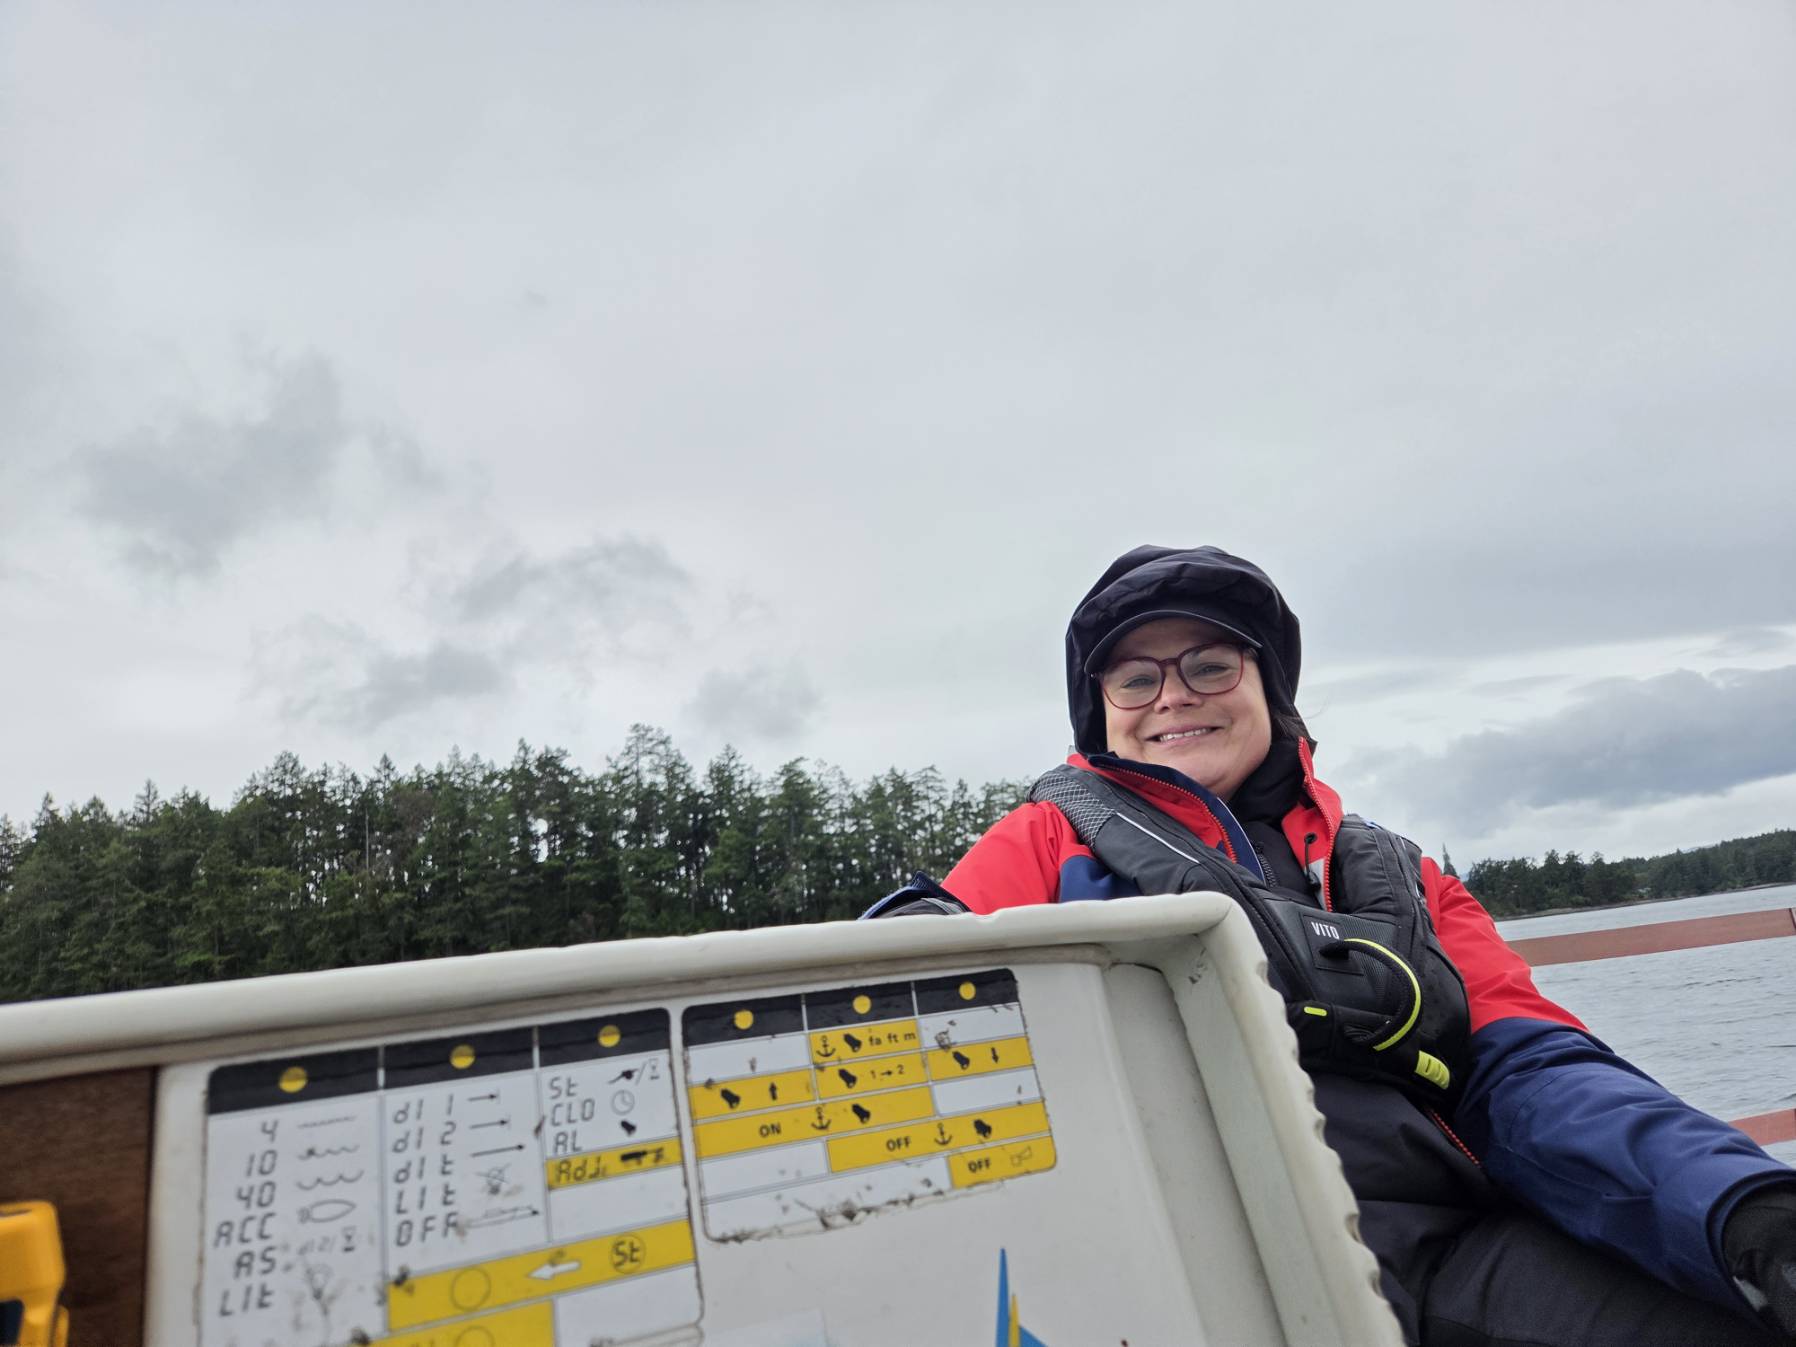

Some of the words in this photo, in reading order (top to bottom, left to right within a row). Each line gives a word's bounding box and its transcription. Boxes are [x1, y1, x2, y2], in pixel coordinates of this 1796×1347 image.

[1311, 921, 1340, 940] VITO
[887, 1032, 898, 1043] ft
[904, 1032, 916, 1041] m
[870, 1070, 876, 1079] 1
[897, 1064, 905, 1075] 2
[261, 1119, 278, 1143] 4
[552, 1130, 582, 1155] AL
[759, 1124, 781, 1139] ON
[886, 1136, 912, 1152] OFF
[245, 1149, 277, 1178] 10
[968, 1158, 992, 1174] OFF
[236, 1181, 276, 1210] 40
[213, 1212, 276, 1248] ACC
[395, 1212, 459, 1248] OFF
[233, 1246, 277, 1280] AS
